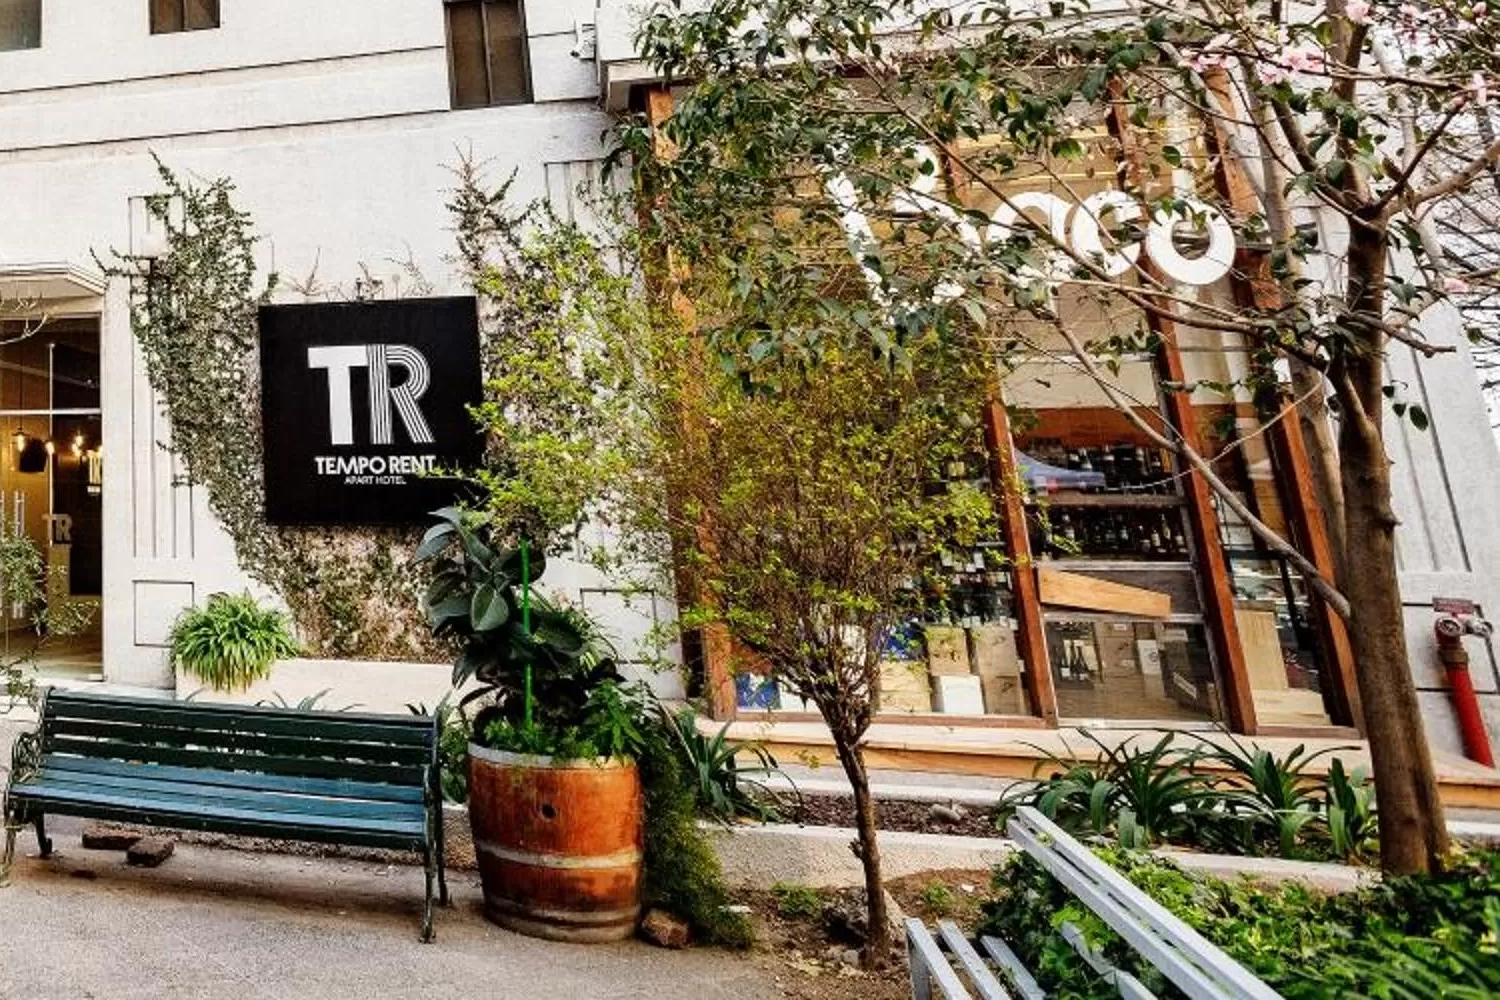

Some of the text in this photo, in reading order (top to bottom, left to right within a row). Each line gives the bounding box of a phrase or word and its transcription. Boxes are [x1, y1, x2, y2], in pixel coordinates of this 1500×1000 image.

[307, 344, 436, 445] TR
[314, 455, 436, 475] TEMPO RENT
[344, 475, 407, 485] APART HOTEL
